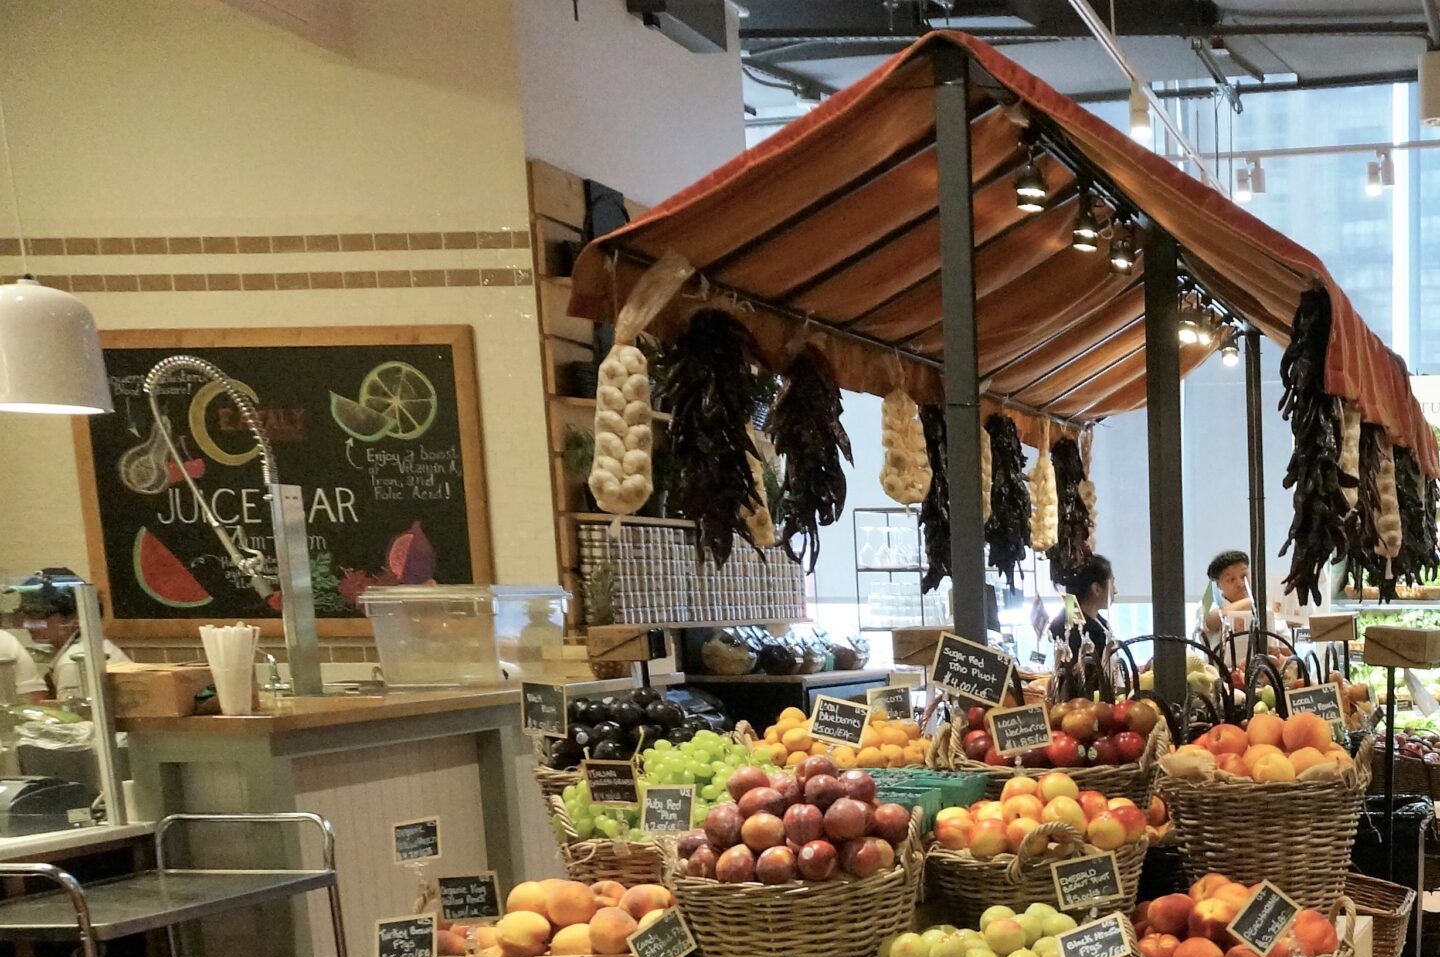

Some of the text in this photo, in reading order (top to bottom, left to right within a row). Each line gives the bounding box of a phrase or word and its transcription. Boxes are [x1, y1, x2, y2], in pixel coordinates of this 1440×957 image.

[366, 447, 400, 467] Enjoy
[406, 472, 434, 487] and
[308, 487, 359, 523] AR
[943, 647, 967, 662] Sugar
[971, 668, 998, 683] Pluot
[997, 715, 1023, 729] Local
[646, 798, 682, 813] Ruby Red
[1066, 934, 1094, 951] Black
